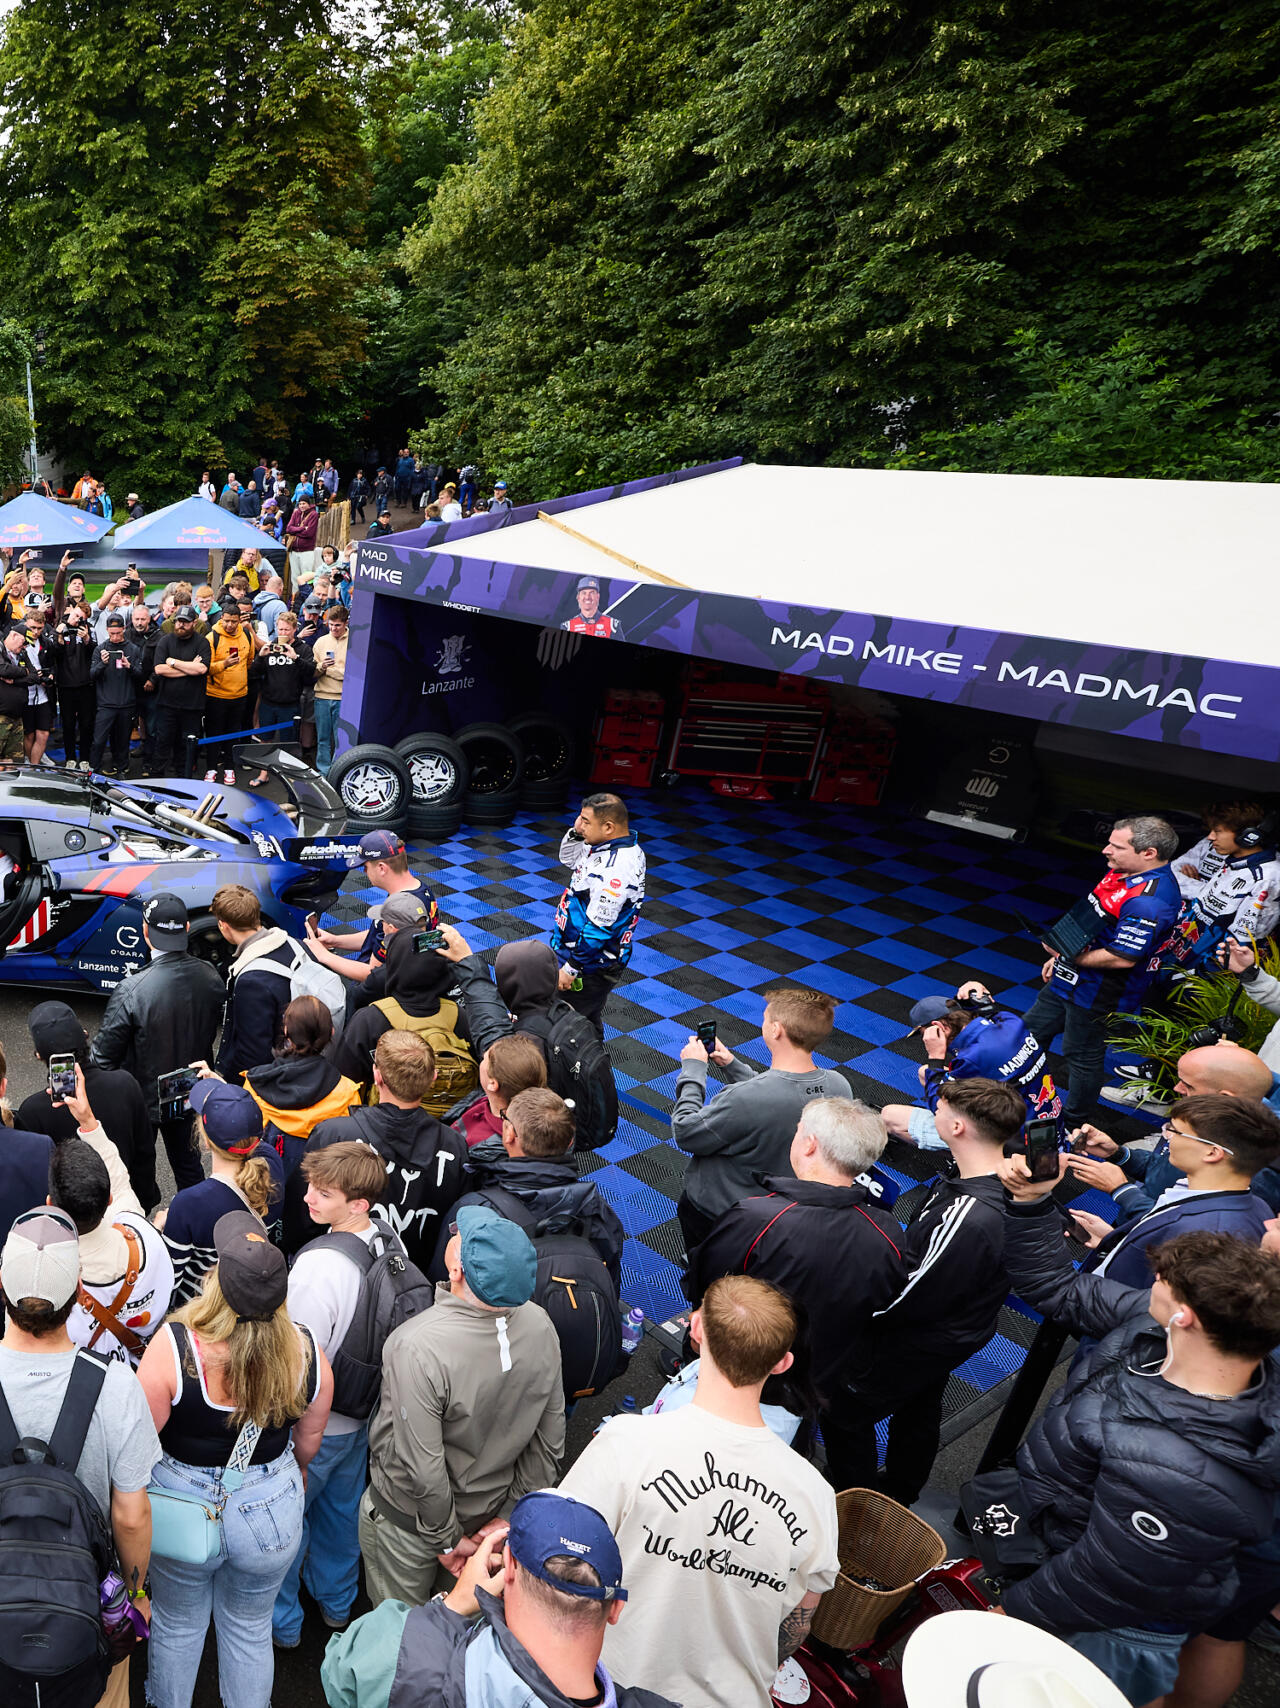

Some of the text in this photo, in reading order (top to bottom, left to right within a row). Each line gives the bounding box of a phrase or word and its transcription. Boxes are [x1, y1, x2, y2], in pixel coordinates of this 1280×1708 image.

[176, 535, 228, 544] Red Bull
[361, 548, 388, 562] MAD
[359, 563, 403, 585] MIKE
[770, 626, 855, 656] MAD
[862, 640, 963, 675] MIKE
[997, 660, 1244, 720] MADMAC
[421, 675, 475, 695] Lanzante
[110, 949, 145, 959] O'GARA
[78, 960, 120, 973] Lanzante
[641, 1451, 808, 1546] Muhammad
[706, 1499, 759, 1546] Ali
